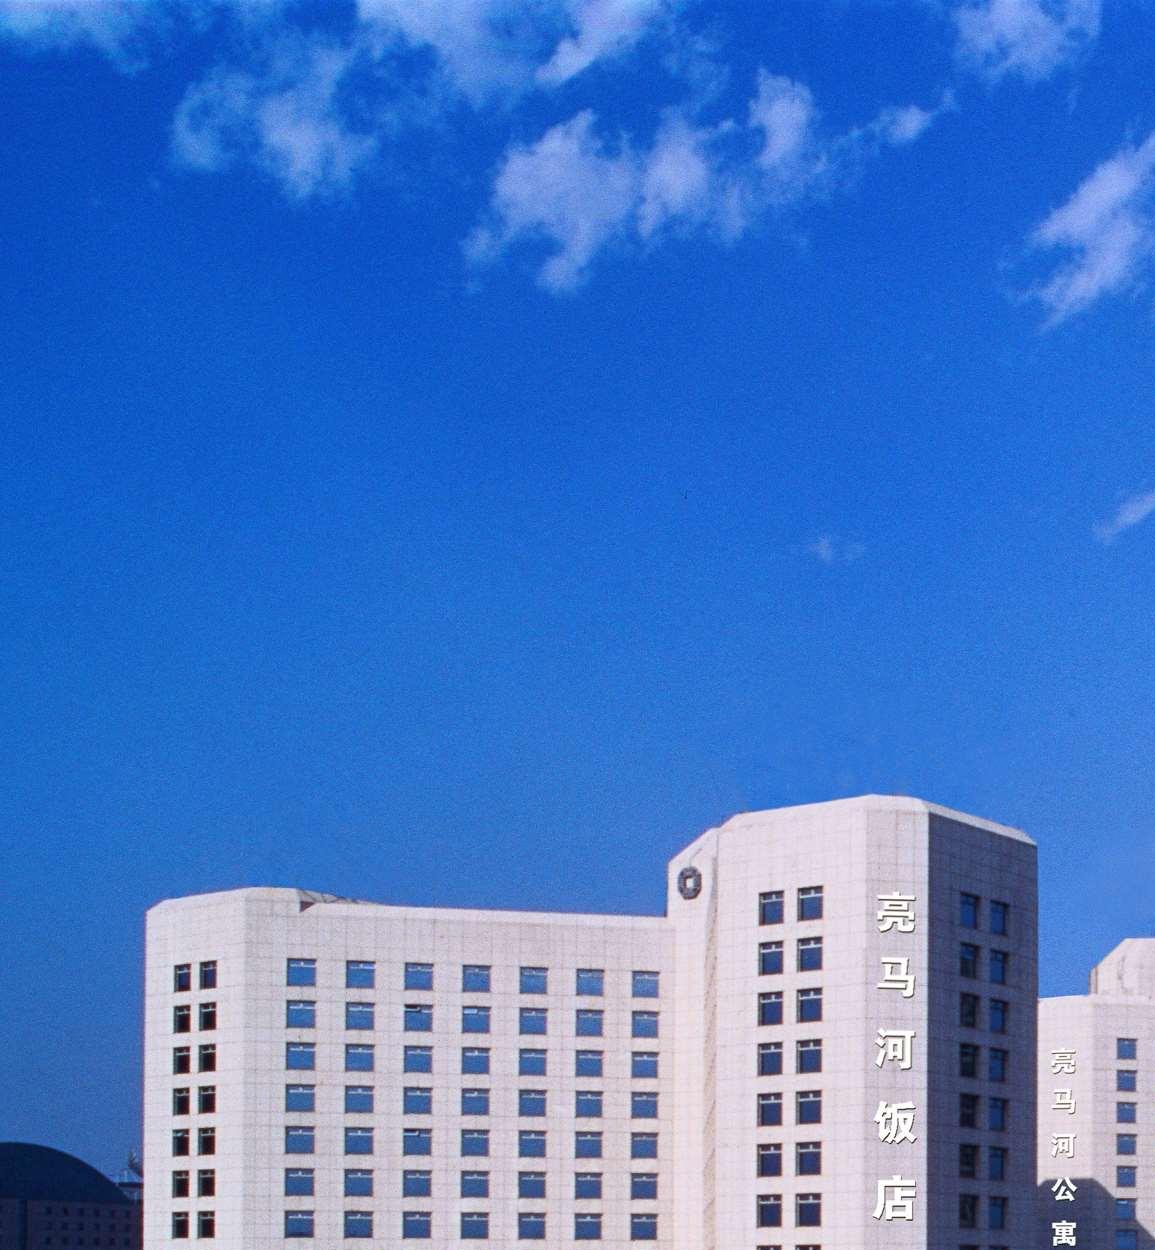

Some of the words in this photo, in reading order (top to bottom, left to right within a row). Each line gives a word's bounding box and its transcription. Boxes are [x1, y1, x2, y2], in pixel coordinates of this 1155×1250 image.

[872, 892, 917, 1221] 亮马河饭店
[1051, 1048, 1077, 1247] 亮马河公寓
